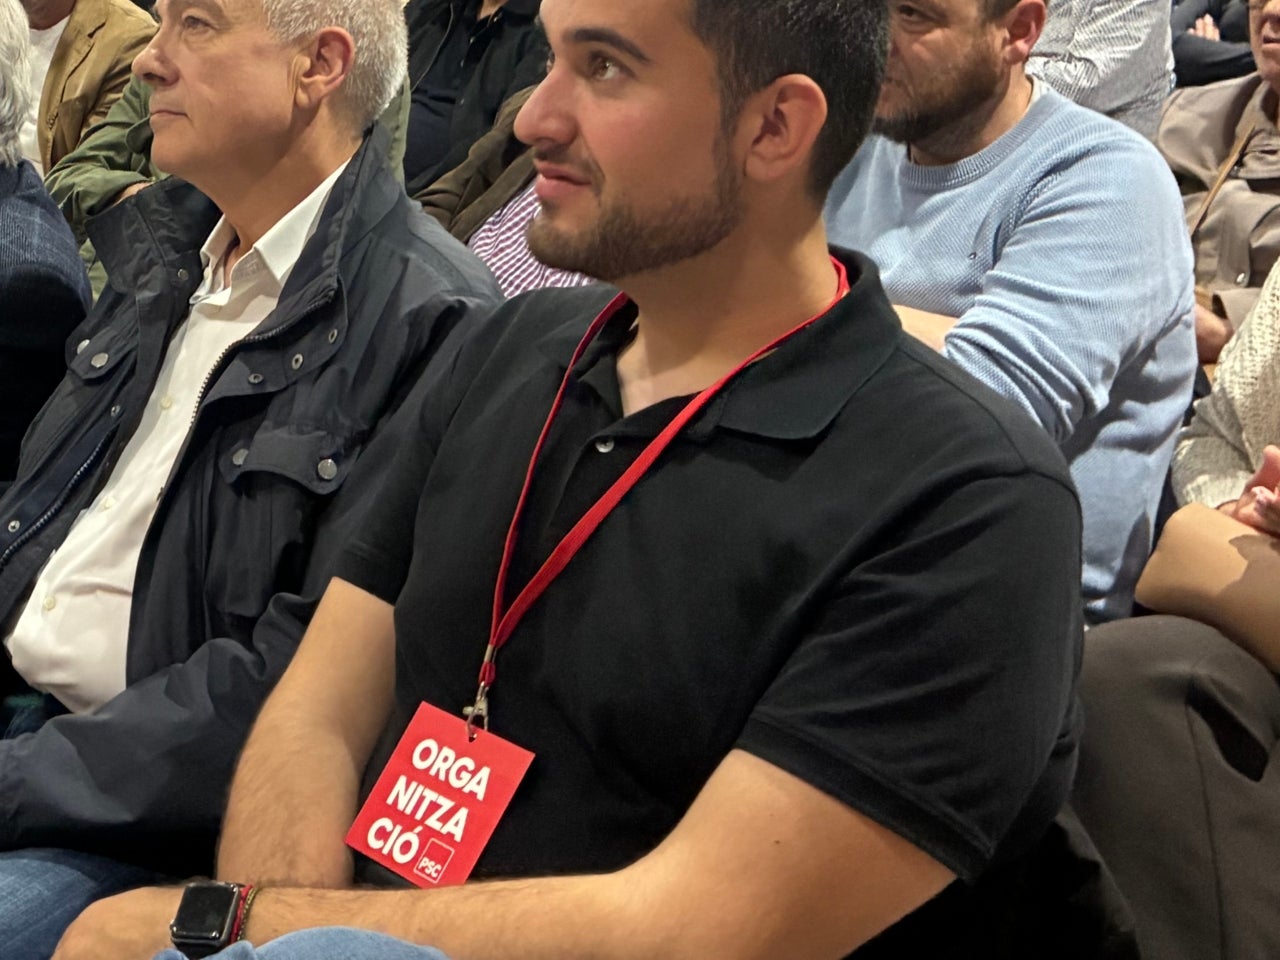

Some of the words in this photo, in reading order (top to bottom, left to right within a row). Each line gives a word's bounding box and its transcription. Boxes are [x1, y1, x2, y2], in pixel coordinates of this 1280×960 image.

[412, 739, 491, 801] ORGA
[386, 775, 469, 843] NITZA
[367, 817, 423, 864] CIÓ
[419, 856, 442, 877] PSC
